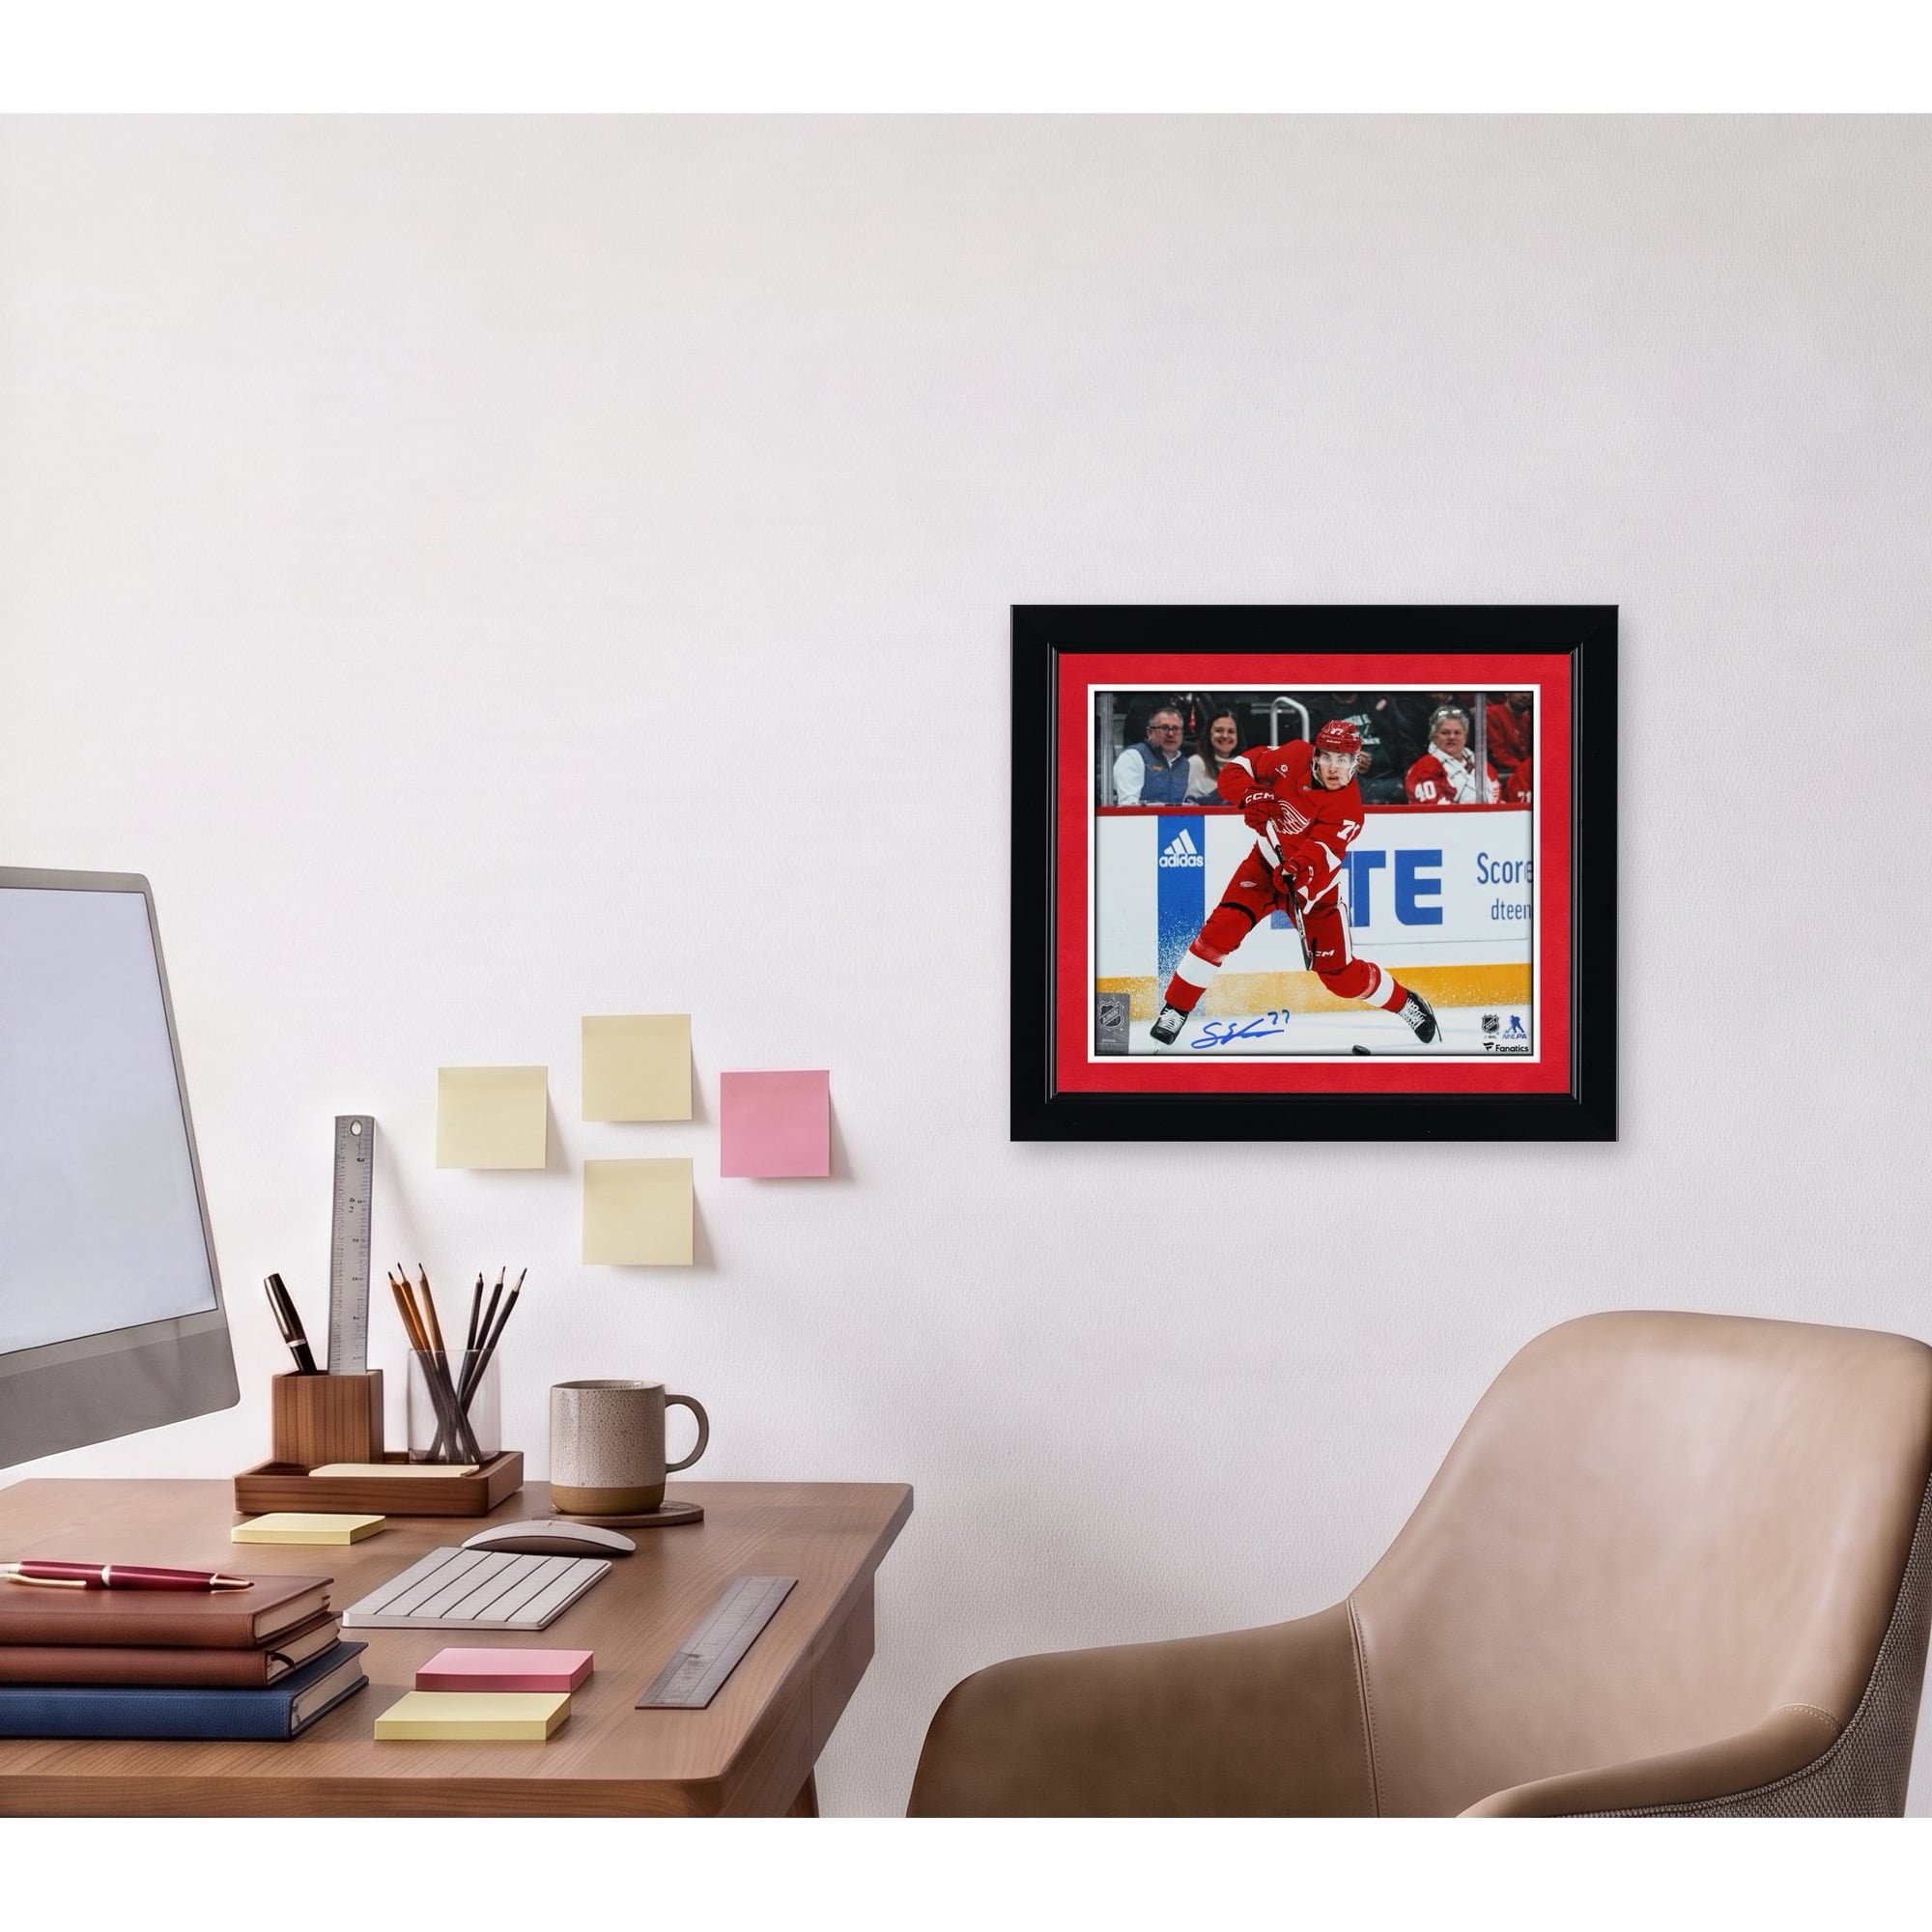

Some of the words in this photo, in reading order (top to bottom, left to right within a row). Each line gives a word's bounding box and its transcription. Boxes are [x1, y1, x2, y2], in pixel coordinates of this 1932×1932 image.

[1245, 792, 1274, 804] CCM
[1414, 781, 1436, 802] 40
[1159, 854, 1204, 867] adidas
[1492, 897, 1532, 920] dteen
